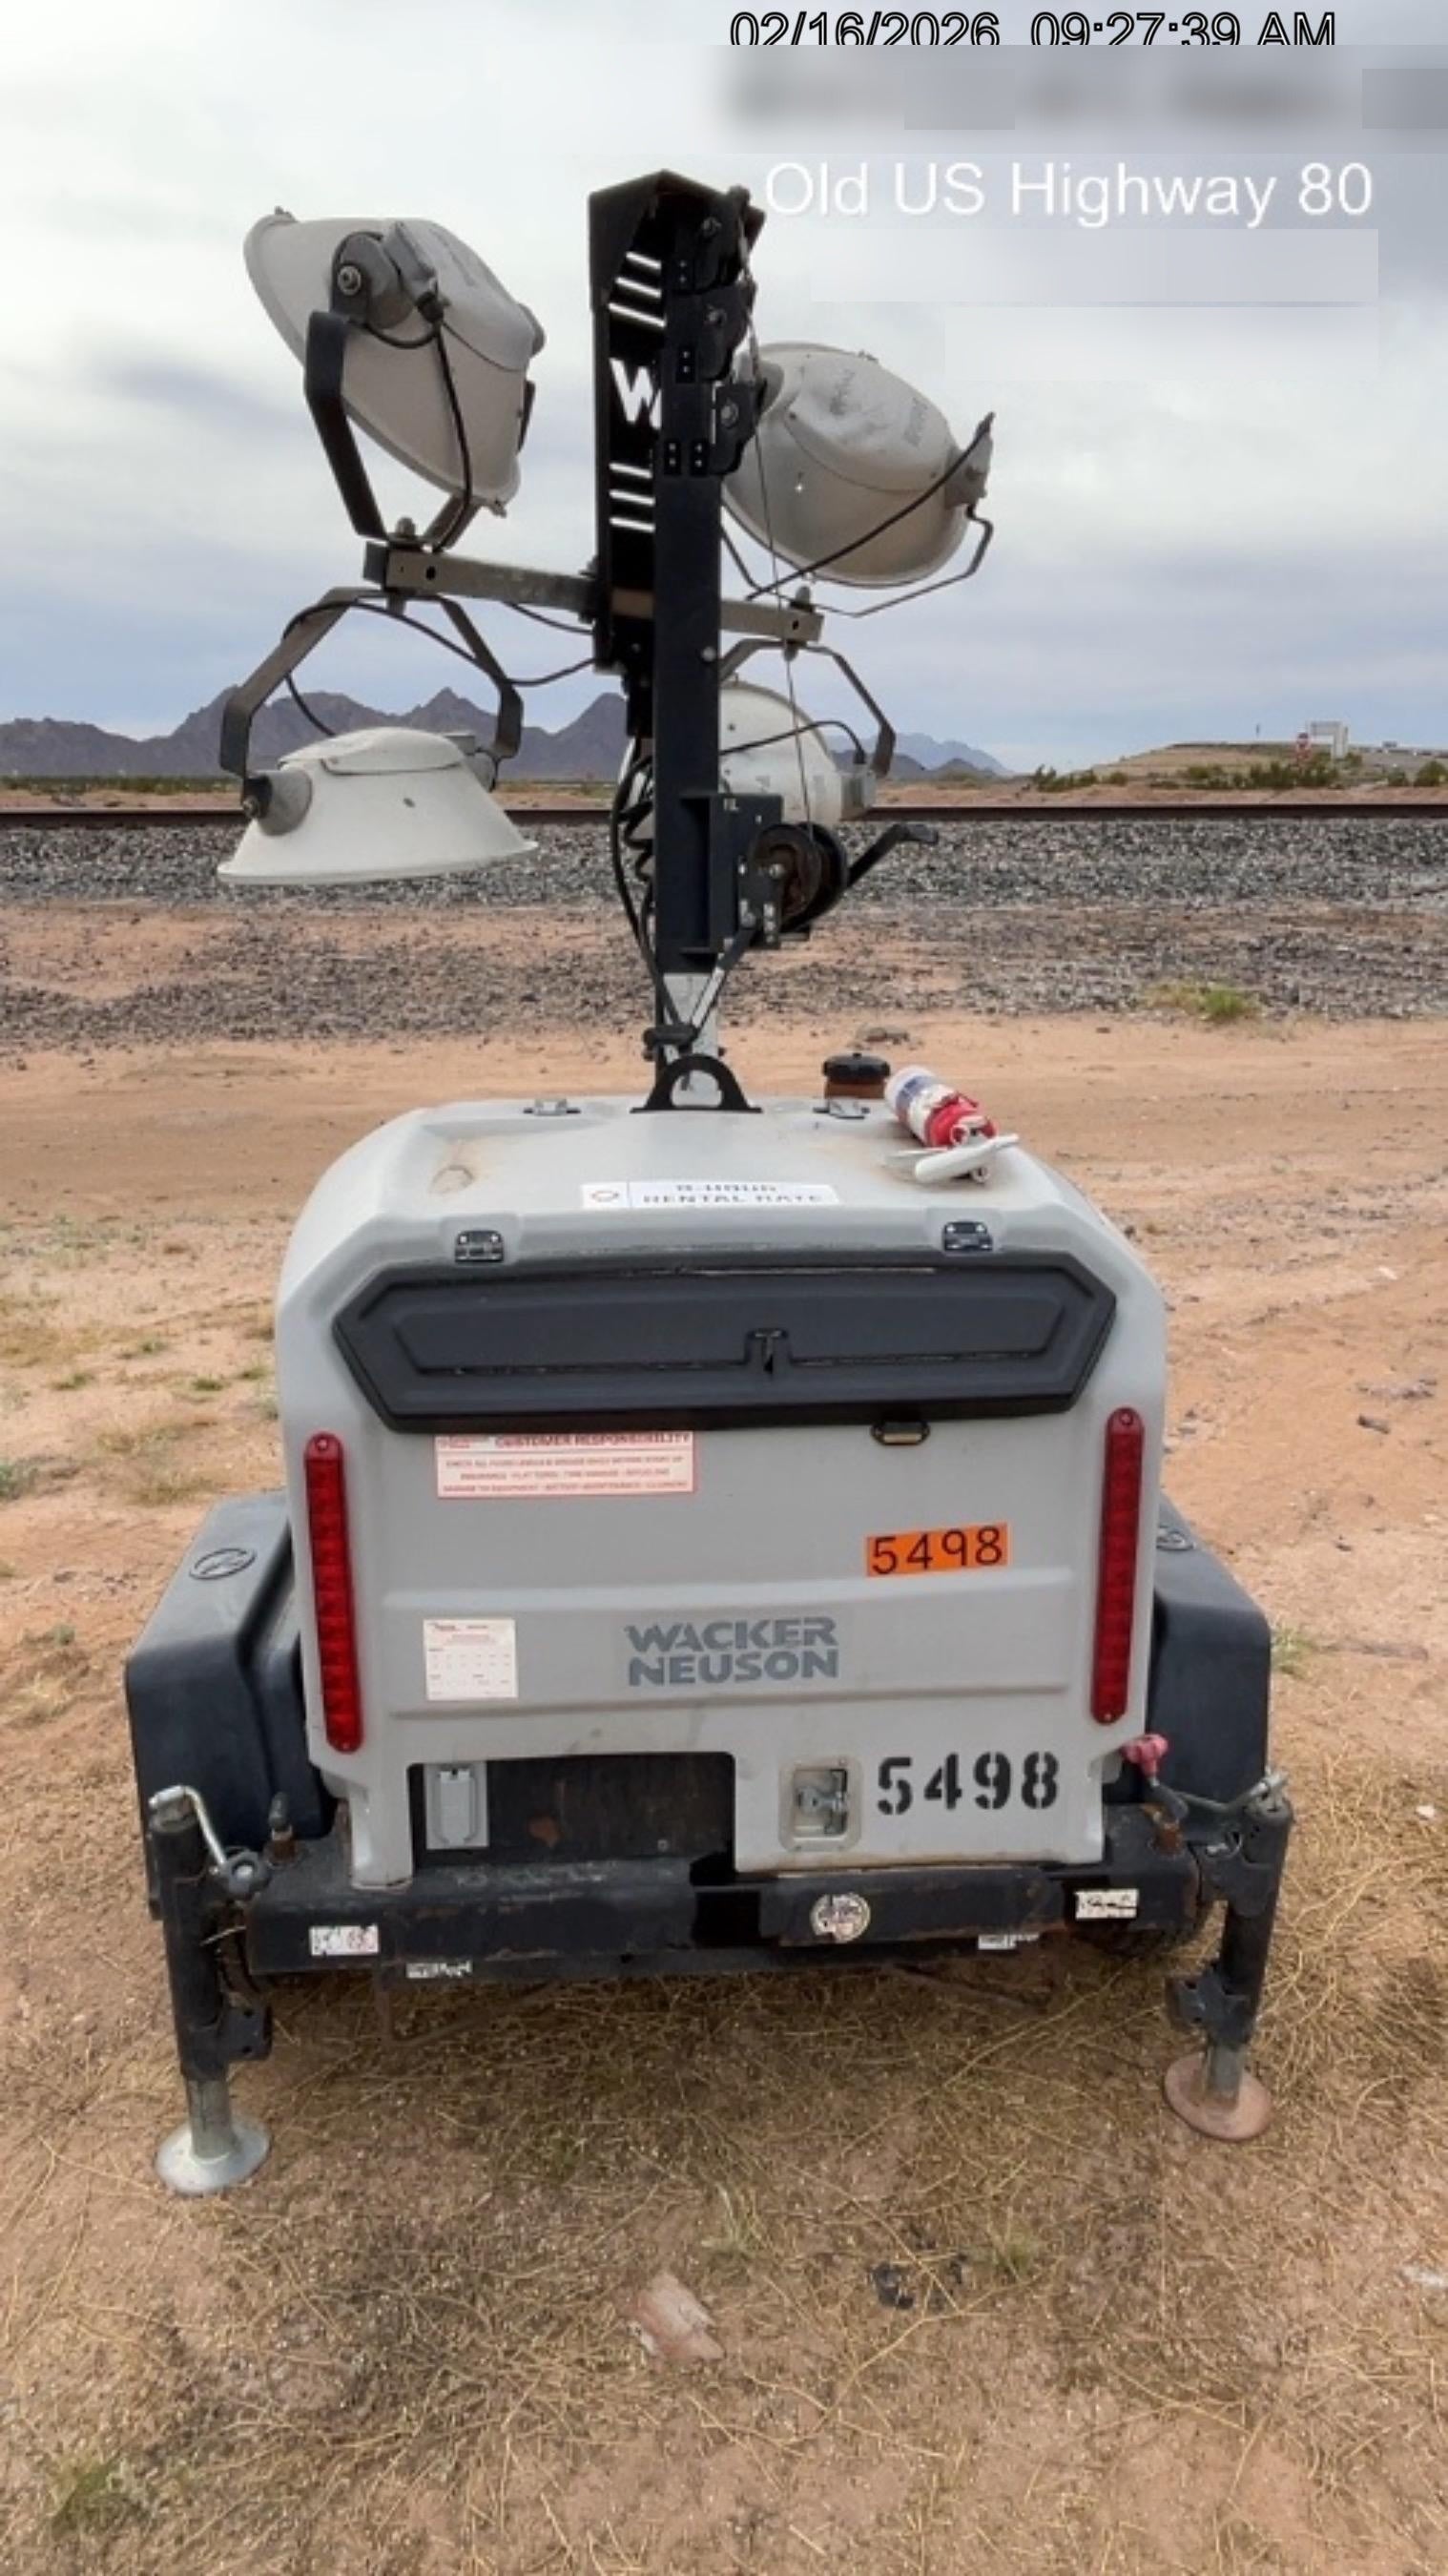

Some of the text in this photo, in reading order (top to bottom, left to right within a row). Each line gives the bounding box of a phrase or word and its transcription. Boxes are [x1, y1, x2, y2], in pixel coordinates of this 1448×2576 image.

[870, 1526, 1004, 1576] 5498
[623, 1615, 839, 1654] WACKER
[628, 1648, 839, 1688] NEUSON
[876, 1750, 1060, 1816] 5498
